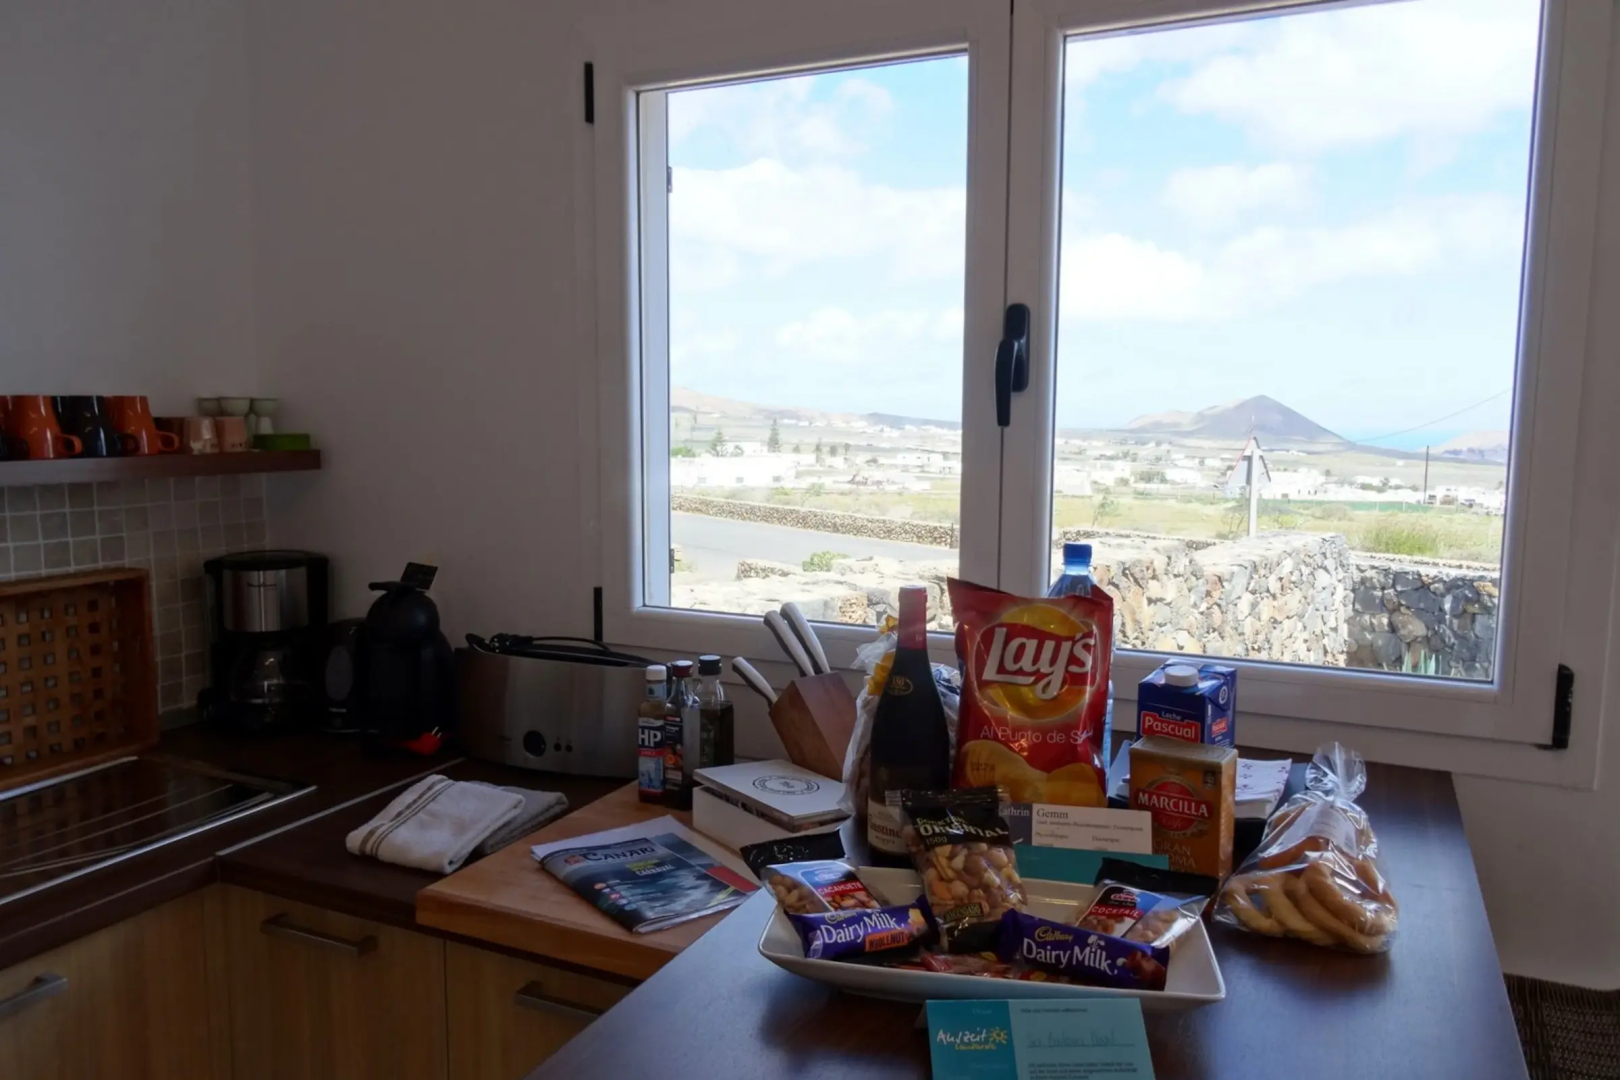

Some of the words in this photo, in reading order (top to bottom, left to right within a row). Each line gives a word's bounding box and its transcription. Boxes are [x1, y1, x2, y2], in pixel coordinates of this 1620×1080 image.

[981, 627, 1095, 701] Lay's
[1161, 711, 1182, 721] Leche
[980, 725, 994, 739] Al
[999, 727, 1043, 744] Punto
[1046, 730, 1066, 743] de
[1144, 716, 1196, 738] Pascual
[638, 728, 662, 747] HP
[1138, 791, 1209, 818] MARCILLA
[1091, 906, 1139, 917] COCKTAIL
[820, 923, 863, 943] Dairy
[863, 913, 900, 932] Milk
[1034, 926, 1074, 943] Cadbury
[1023, 937, 1072, 969] Dairy
[1072, 946, 1112, 975] Milk
